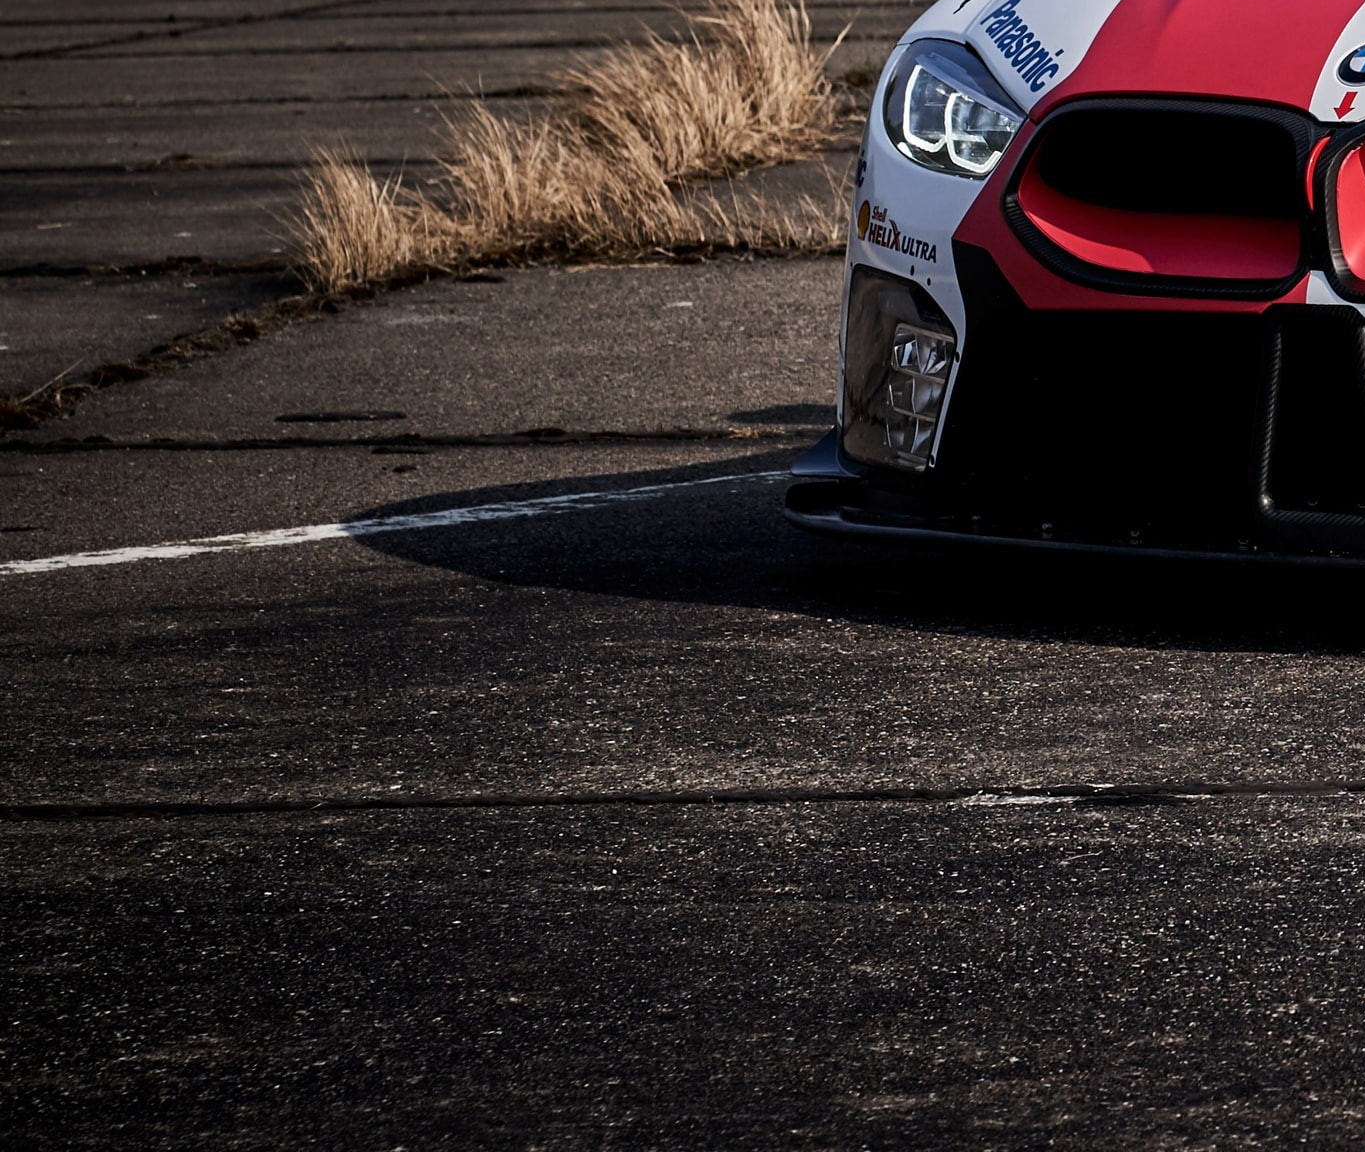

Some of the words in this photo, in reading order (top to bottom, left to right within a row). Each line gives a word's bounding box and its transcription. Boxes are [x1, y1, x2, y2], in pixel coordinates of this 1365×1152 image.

[872, 206, 888, 223] Shell
[868, 222, 901, 252] HELIX
[901, 235, 937, 263] ULTRA
